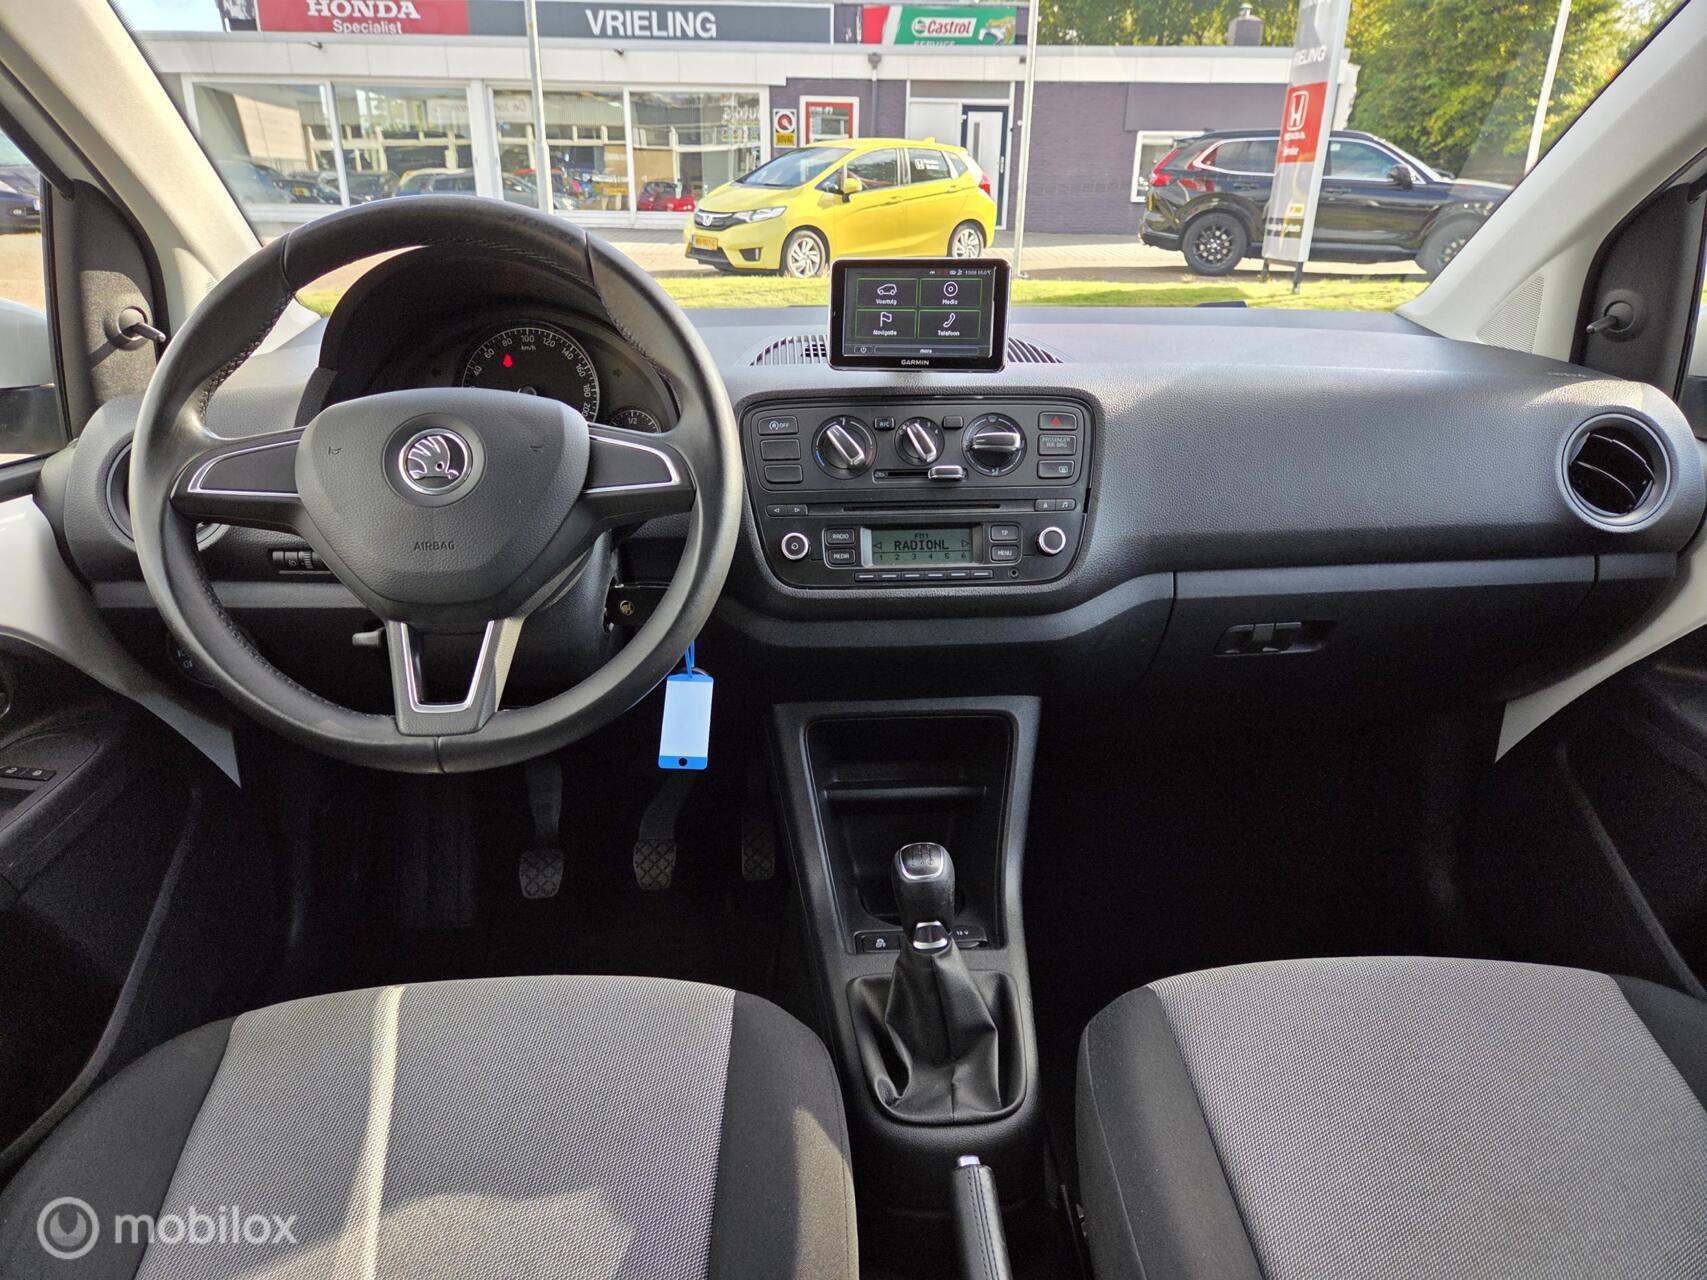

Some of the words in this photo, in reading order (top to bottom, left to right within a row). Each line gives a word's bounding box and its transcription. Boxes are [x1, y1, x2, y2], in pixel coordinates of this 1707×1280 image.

[306, 0, 421, 19] HONDA
[332, 19, 403, 34] Specialist
[585, 9, 717, 39] VRIELING
[927, 20, 971, 34] Castrol
[502, 338, 512, 347] 80
[543, 338, 556, 348] 120
[484, 348, 495, 358] 60
[561, 347, 574, 360] 140
[575, 363, 586, 377] 160
[583, 384, 591, 398] 180
[581, 402, 591, 417] 200
[414, 541, 455, 550] AIRBAG
[894, 539, 949, 551] RADIONL
